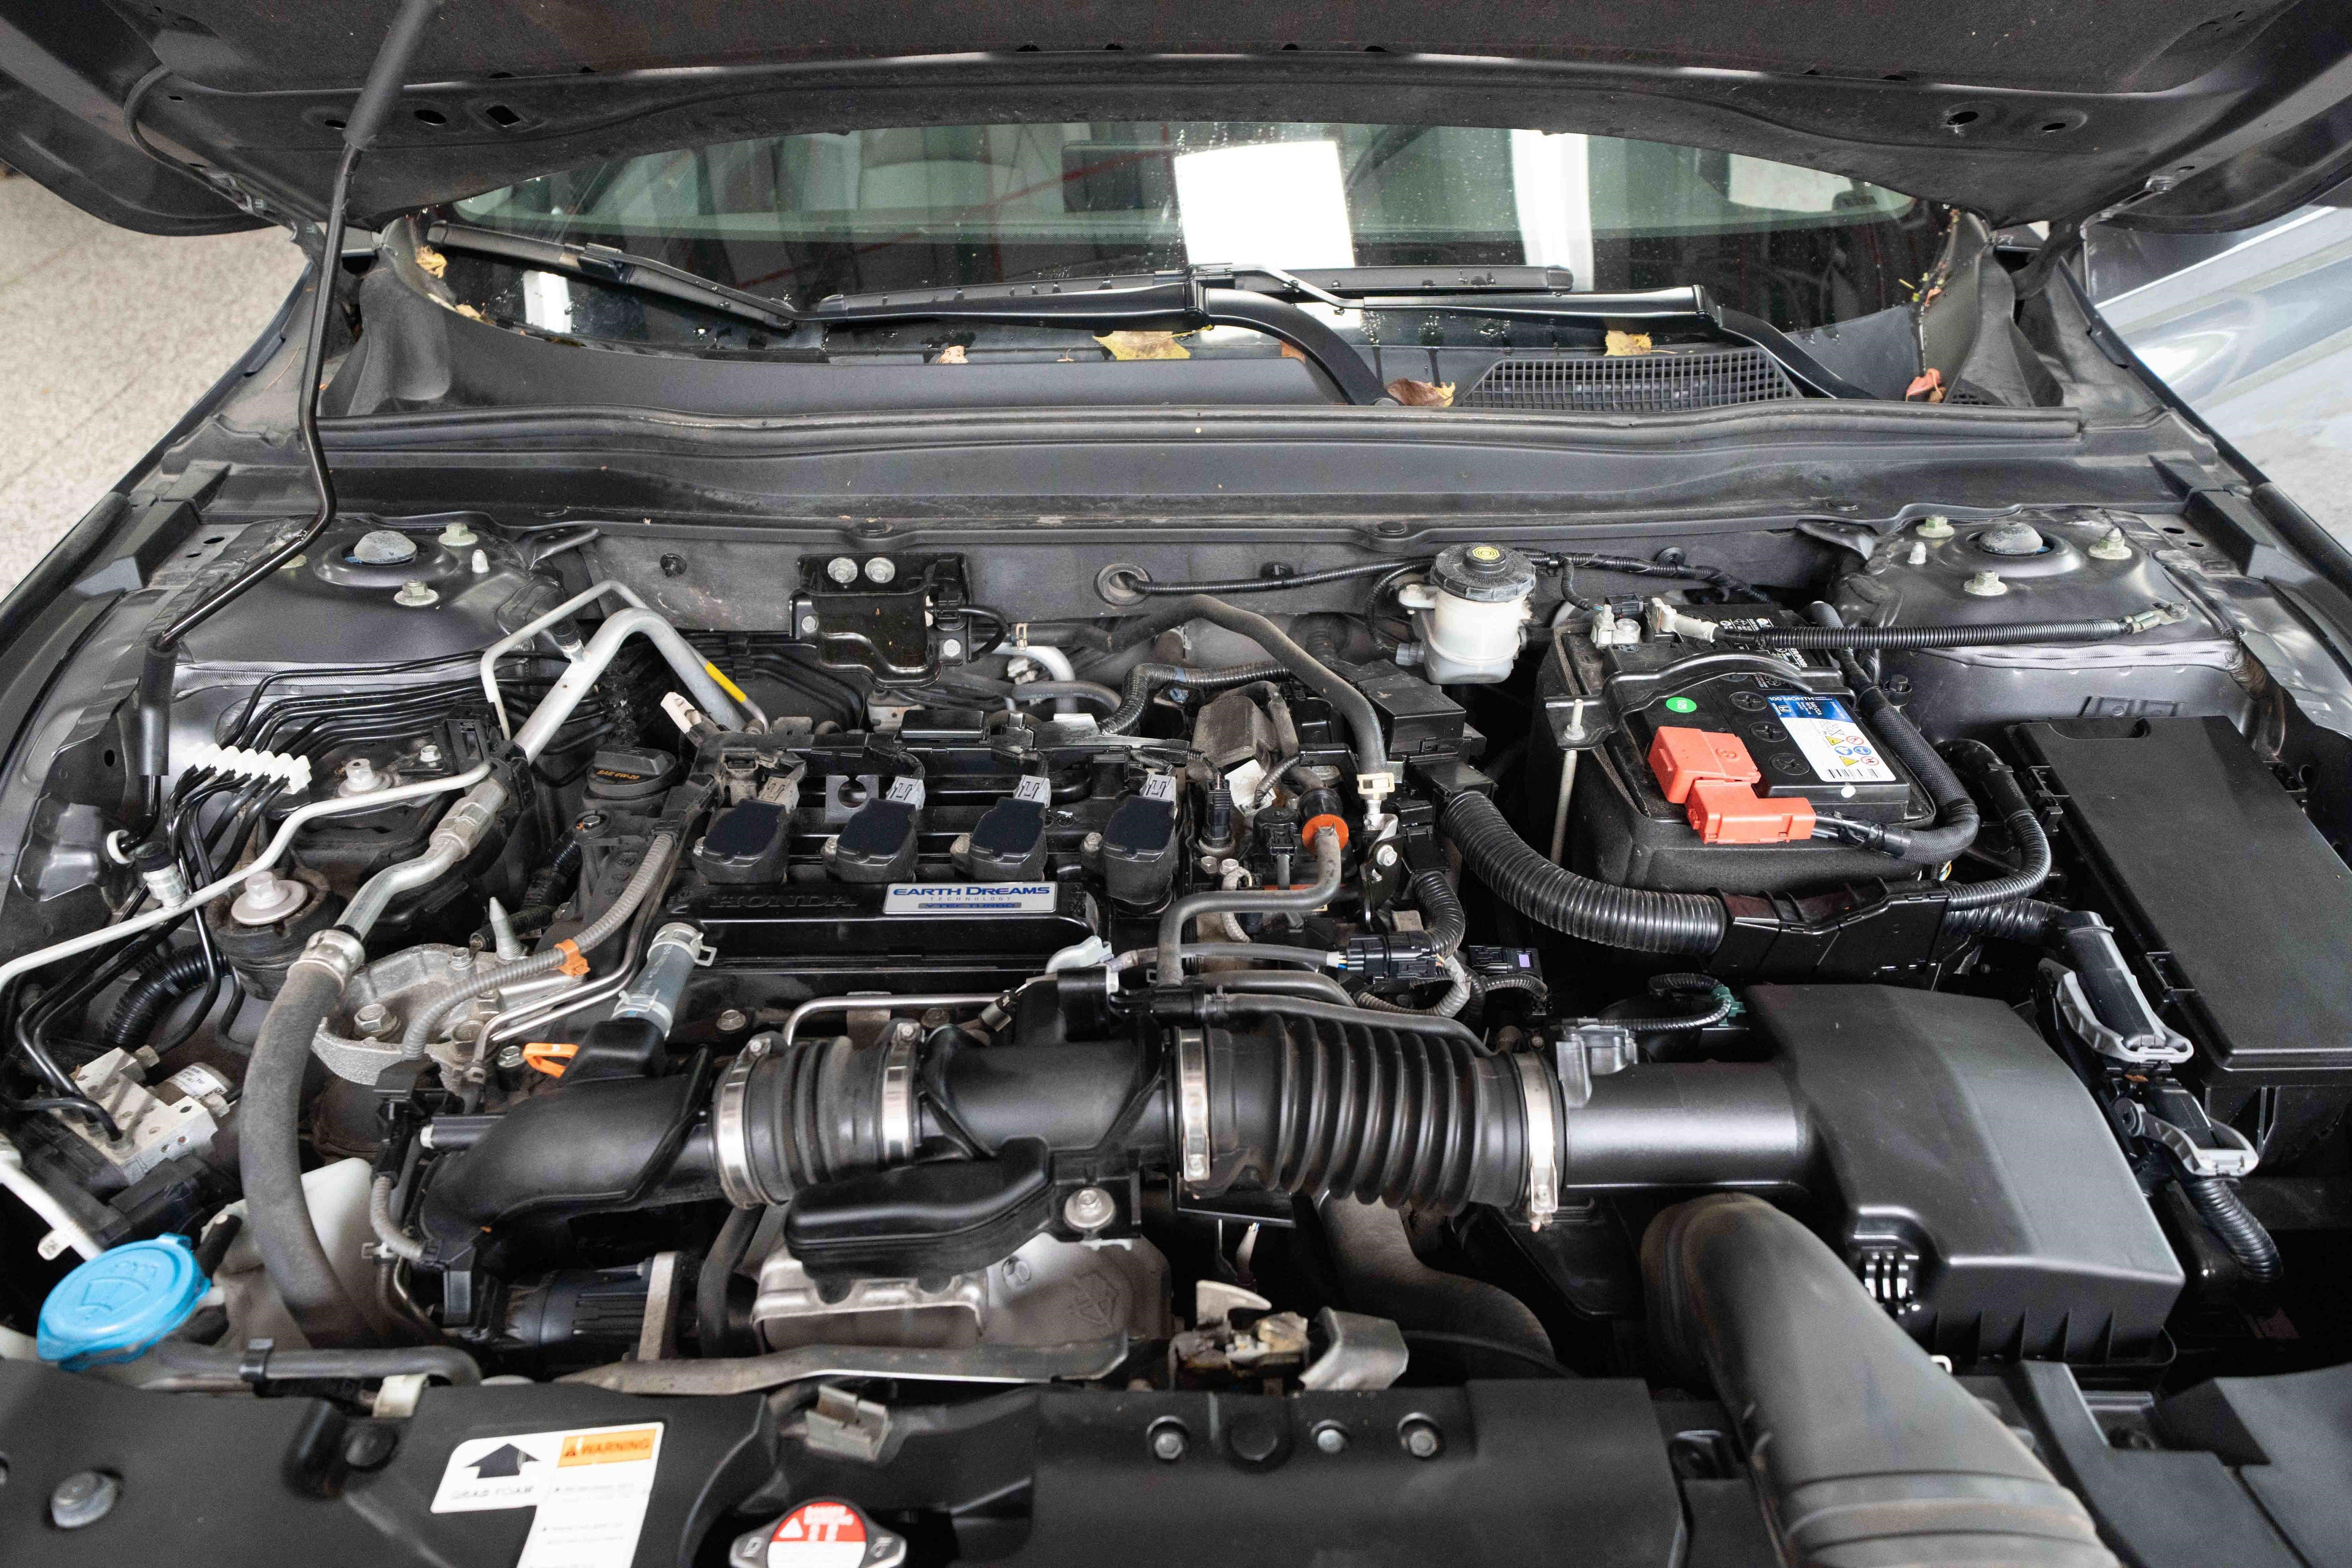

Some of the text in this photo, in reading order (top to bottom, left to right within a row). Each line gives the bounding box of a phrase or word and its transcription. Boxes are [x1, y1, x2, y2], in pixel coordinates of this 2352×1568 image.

[1771, 703, 1782, 715] HONDA
[966, 887, 1050, 895] DREAMS
[708, 895, 858, 908] HONDA
[581, 1438, 651, 1455] WARNING
